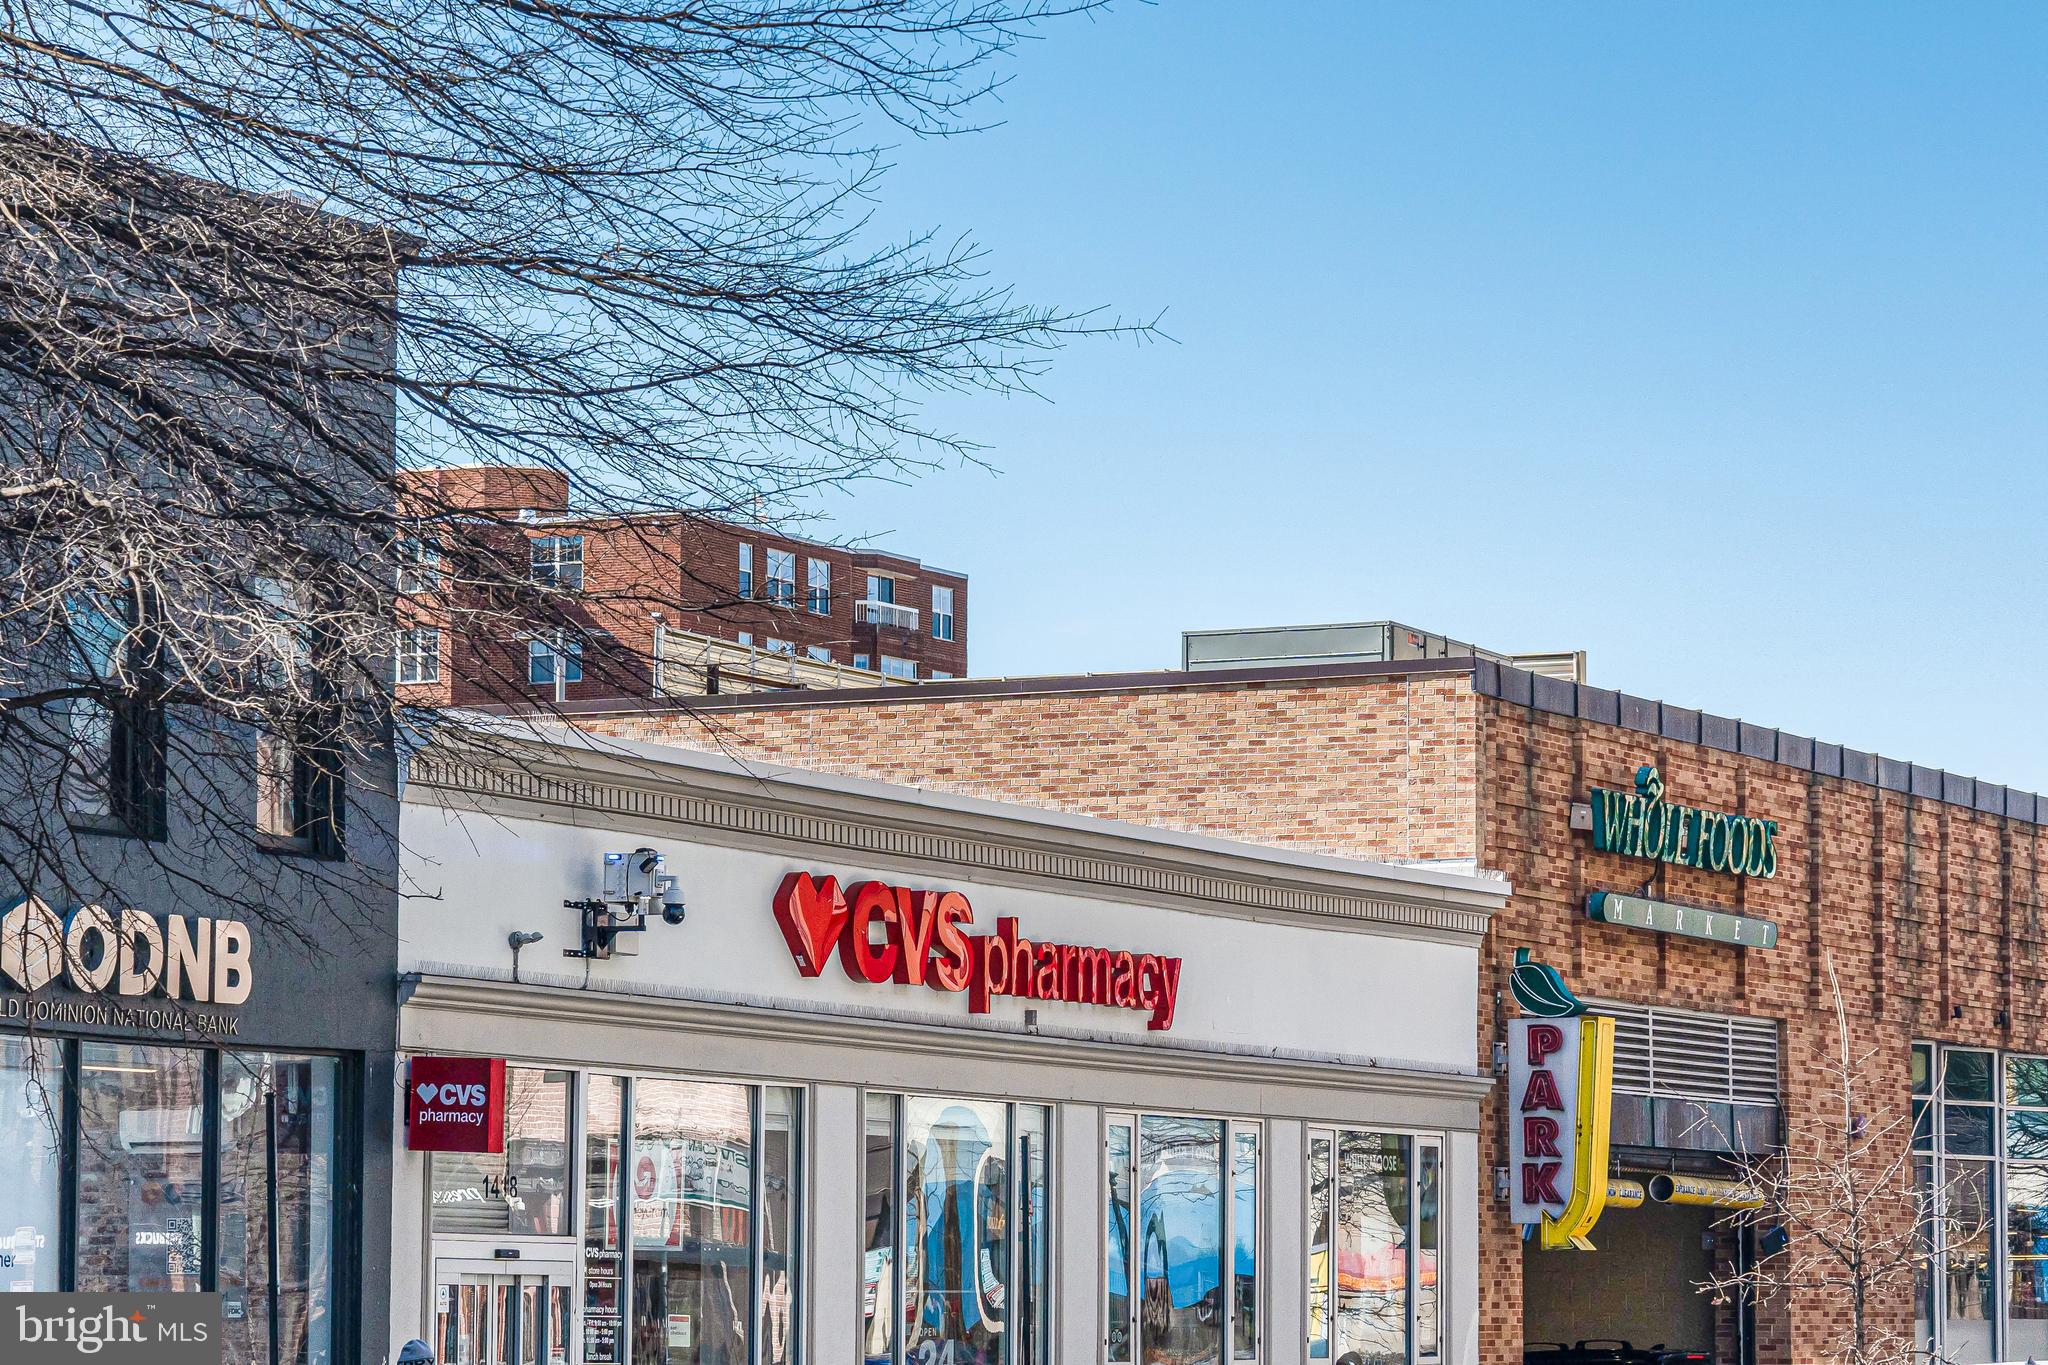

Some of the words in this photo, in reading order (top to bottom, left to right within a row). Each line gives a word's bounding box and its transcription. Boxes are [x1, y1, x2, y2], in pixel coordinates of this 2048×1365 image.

[1593, 788, 1694, 866] WHOLE
[1695, 810, 1777, 879] FOODS
[1613, 899, 1770, 946] MARKET
[65, 903, 253, 1005] ODNB
[838, 879, 975, 993] CVS
[968, 916, 1183, 1032] pharmacy
[26, 1000, 107, 1025] DOMINION
[112, 1008, 192, 1032] NATIONAL
[197, 1013, 239, 1036] BANK
[439, 1083, 486, 1106] CVS
[419, 1107, 484, 1127] pharmacy
[1520, 1024, 1565, 1205] PARK
[482, 1174, 518, 1199] 1418
[585, 1247, 599, 1258] CVS
[599, 1249, 623, 1261] pharmacy
[600, 1266, 614, 1275] hours
[604, 1305, 618, 1314] hours
[919, 1327, 937, 1337] OPEN
[918, 1338, 955, 1365] 24
